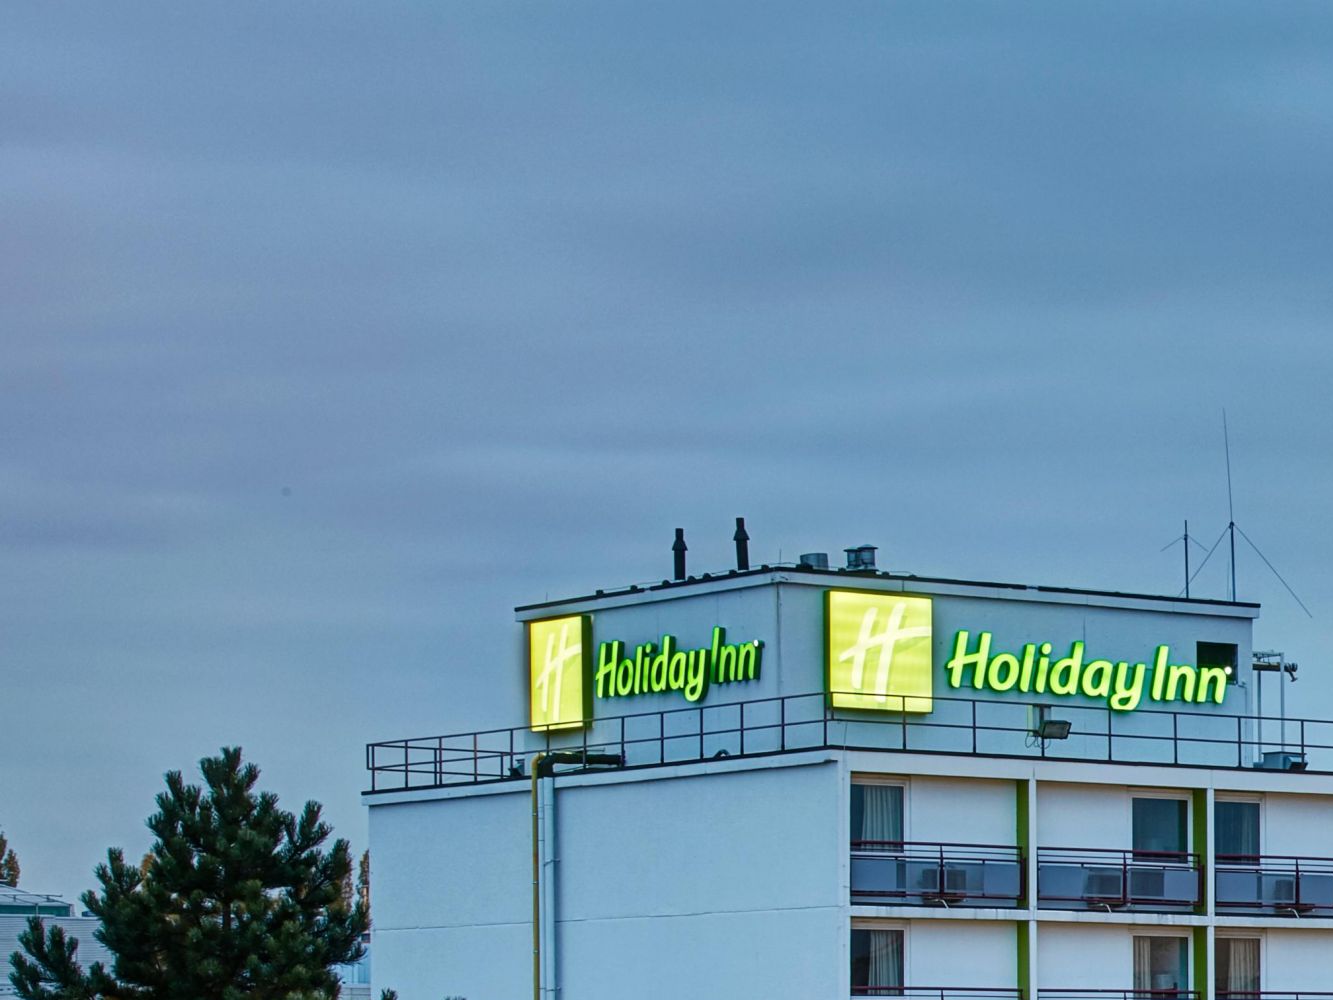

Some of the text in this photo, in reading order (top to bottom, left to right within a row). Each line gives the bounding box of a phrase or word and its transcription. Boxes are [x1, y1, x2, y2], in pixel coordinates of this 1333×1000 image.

[596, 626, 760, 702] Holiday Inn
[947, 631, 1232, 710] Holiday Inn
